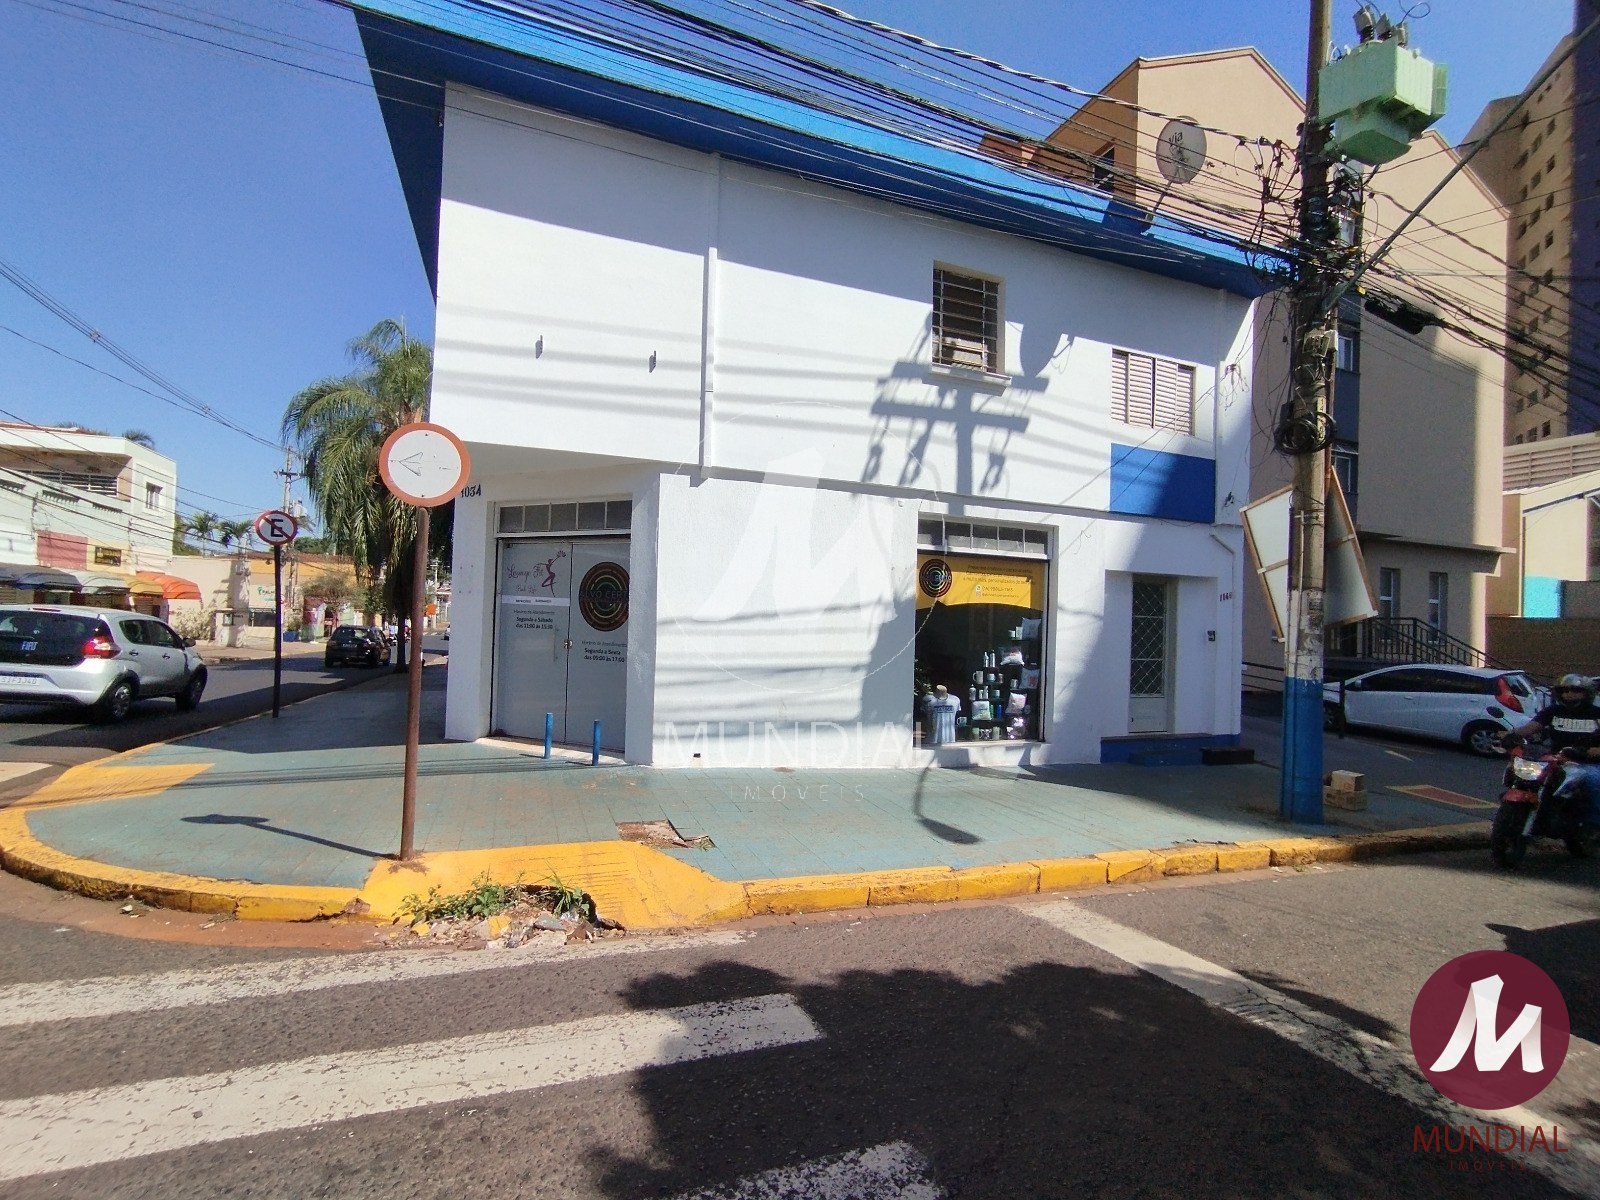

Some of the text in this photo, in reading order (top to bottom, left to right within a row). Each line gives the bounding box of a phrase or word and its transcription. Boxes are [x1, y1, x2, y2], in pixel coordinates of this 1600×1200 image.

[460, 484, 482, 498] 1034
[271, 518, 284, 537] E
[605, 590, 628, 599] CERT
[21, 641, 38, 651] FIAT
